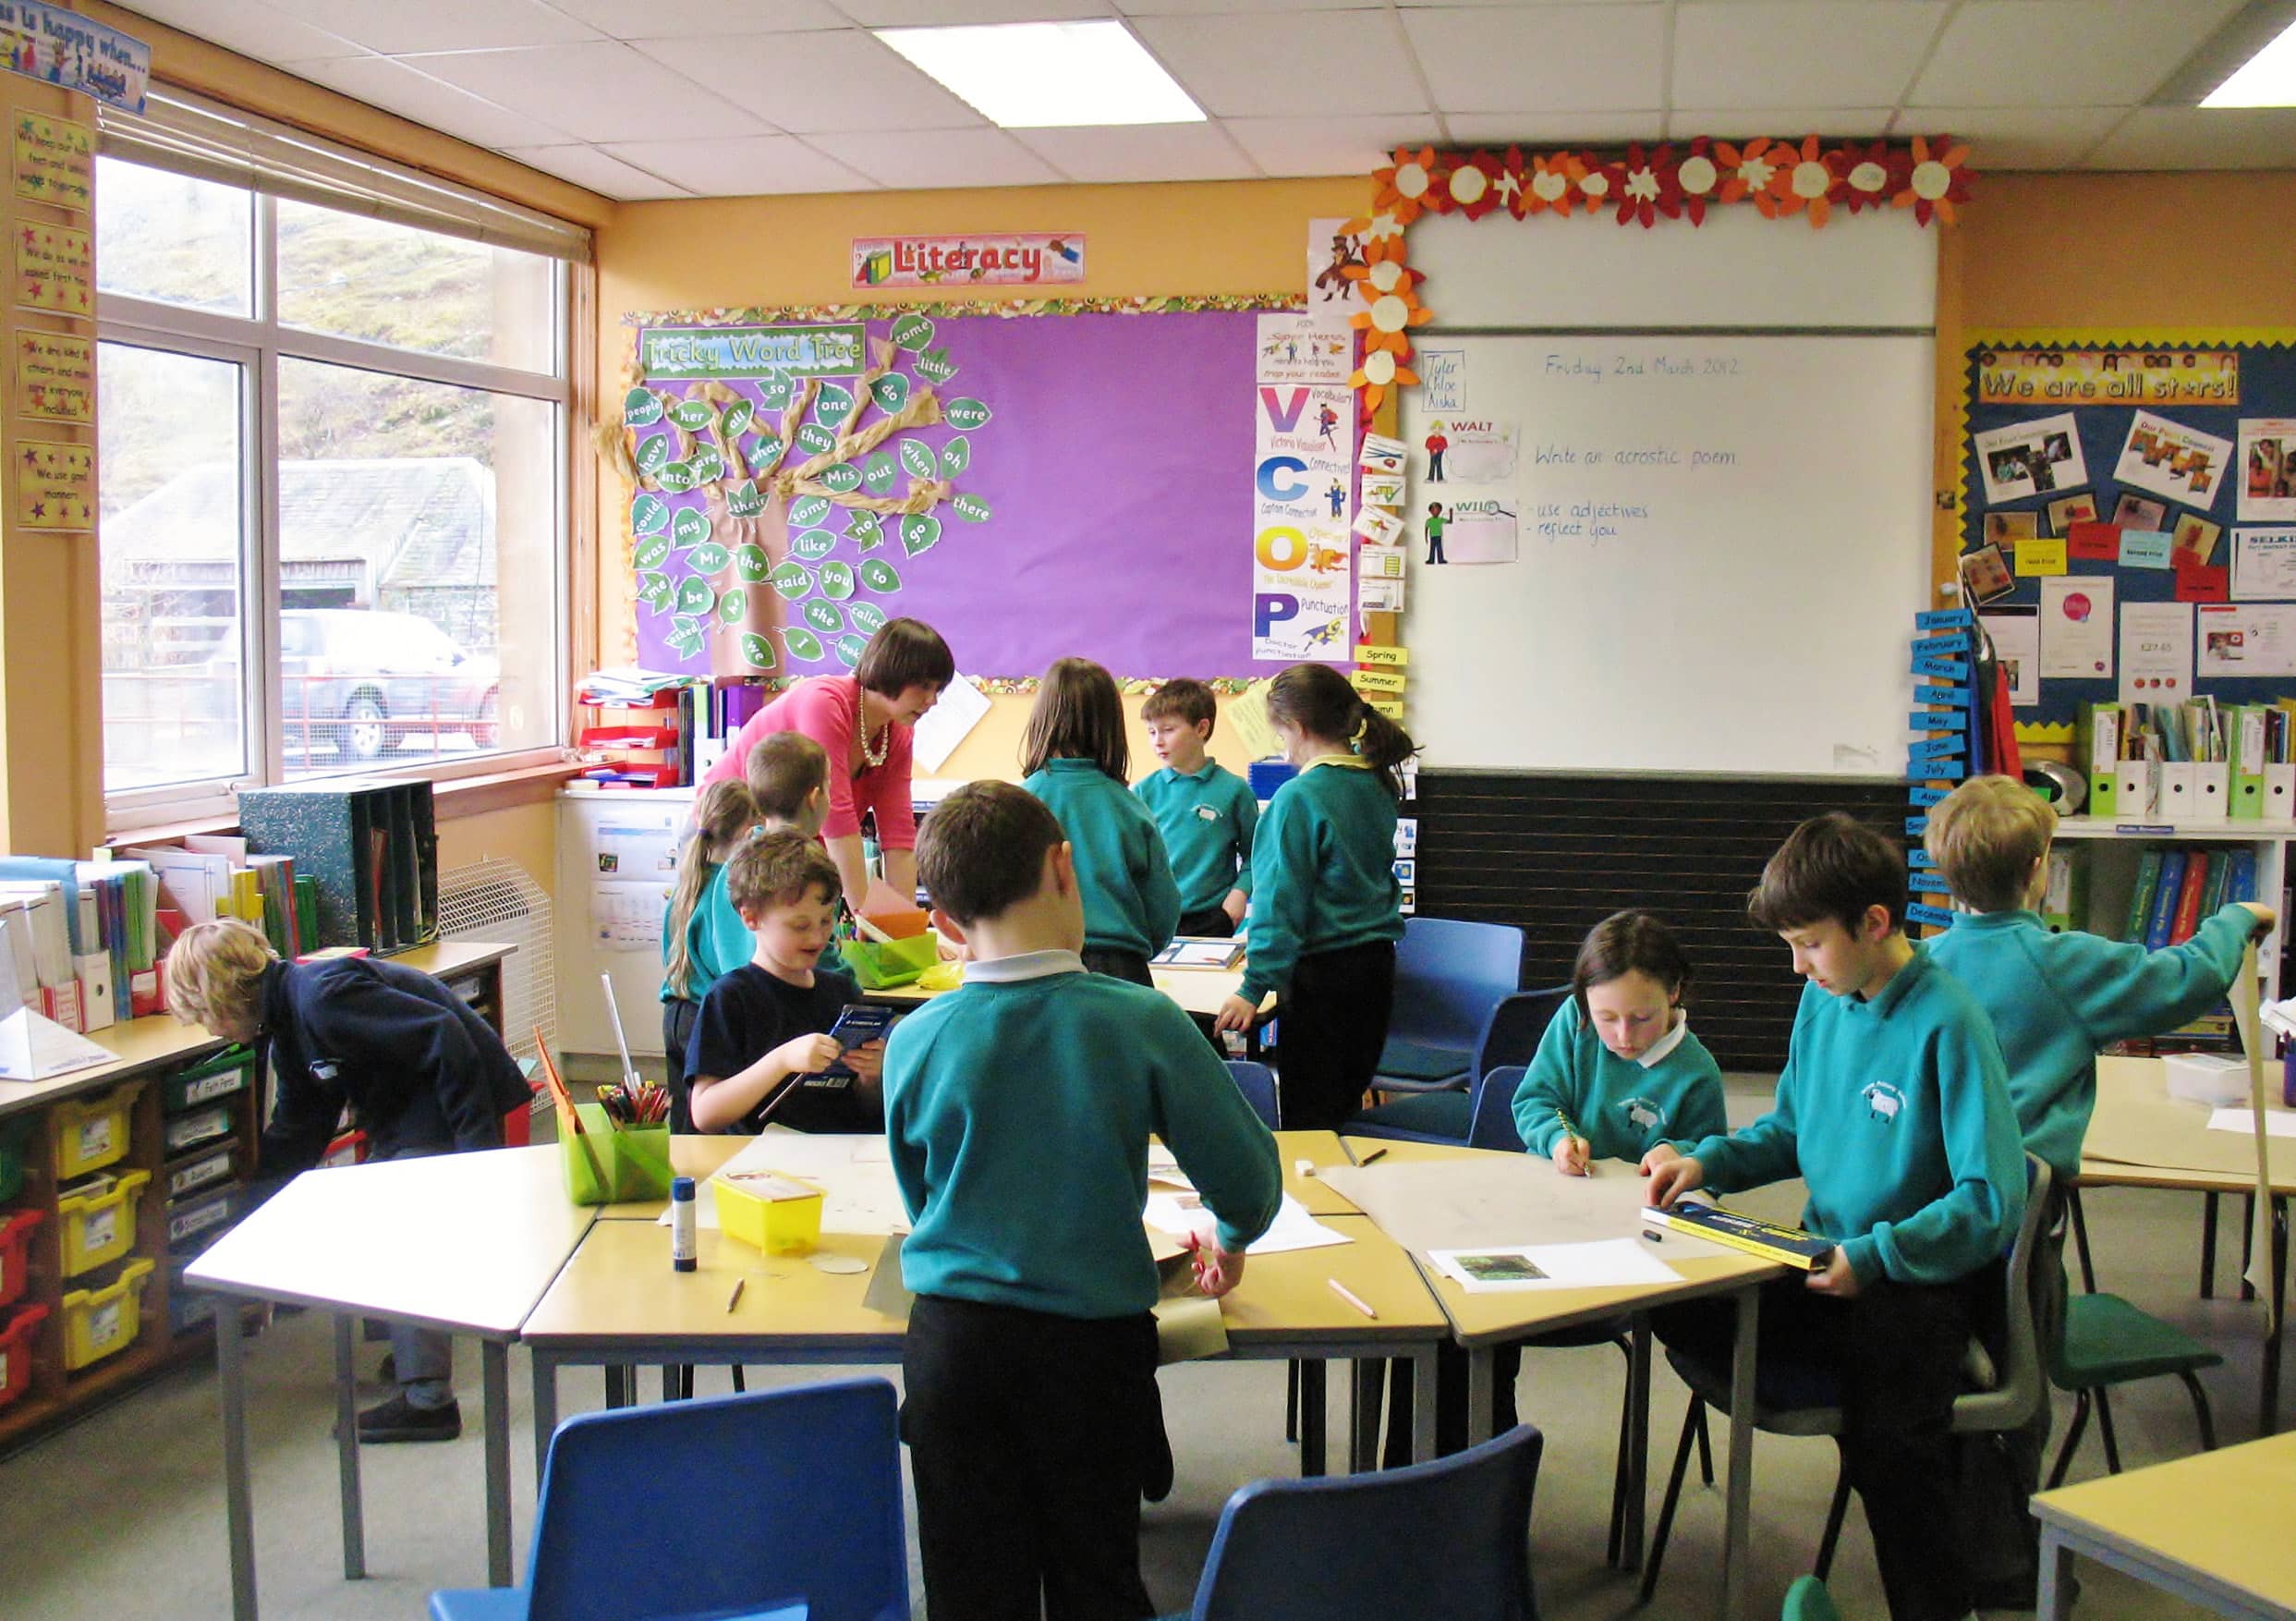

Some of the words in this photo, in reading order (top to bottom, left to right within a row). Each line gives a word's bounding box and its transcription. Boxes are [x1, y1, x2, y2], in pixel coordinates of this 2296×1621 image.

[43, 11, 94, 57] happy
[893, 239, 1042, 282] Literacy
[895, 320, 929, 345] come
[648, 339, 719, 370] Tricky
[729, 338, 801, 362] Word
[810, 335, 862, 360] Tree
[920, 358, 953, 376] little
[1427, 355, 1457, 378] Tyler
[1546, 354, 1602, 383] Friday
[1615, 356, 1644, 375] 2nd
[1653, 356, 1695, 374] March
[769, 384, 786, 396] so
[881, 383, 898, 402] do
[1426, 376, 1456, 394] Chloe
[1984, 372, 2035, 397] We
[2044, 379, 2097, 398] are
[2107, 373, 2144, 399] all
[626, 401, 662, 421] people
[820, 400, 848, 412] one
[950, 407, 986, 420] were
[1259, 387, 1311, 433] V
[679, 409, 705, 423] her
[728, 411, 747, 431] all
[1452, 421, 1493, 432] WALT
[799, 428, 832, 451] they
[2182, 435, 2216, 452] Council
[638, 438, 666, 471] have
[696, 452, 719, 469] are
[747, 440, 782, 466] what
[902, 442, 931, 478] when
[943, 452, 962, 469] oh
[1536, 446, 1576, 464] Write
[1584, 451, 1601, 464] an
[1614, 446, 1680, 464] acrostic
[1692, 449, 1736, 472] poem
[37, 469, 52, 480] We
[661, 469, 691, 485] into
[827, 470, 856, 484] Mrs
[867, 465, 893, 482] out
[1257, 456, 1309, 502] C
[732, 496, 767, 513] their
[791, 498, 830, 524] some
[953, 496, 990, 520] there
[1456, 502, 1496, 512] WILF
[635, 503, 663, 533] could
[1537, 505, 1561, 518] use
[1570, 501, 1649, 530] adjectives
[678, 518, 702, 537] my
[855, 520, 874, 537] no
[909, 523, 927, 543] go
[1537, 520, 1583, 538] reflect
[1589, 522, 1618, 547] you
[639, 542, 667, 564] was
[800, 540, 828, 553] like
[1256, 526, 1308, 571] O
[699, 552, 723, 566] Mr
[739, 555, 762, 572] the
[775, 574, 808, 590] said
[823, 570, 851, 589] you
[871, 568, 888, 585] to
[648, 579, 668, 600] me
[686, 590, 704, 603] be
[1255, 593, 1299, 637] P
[1301, 598, 1348, 615] Punctuation
[810, 606, 836, 627] she
[851, 605, 888, 630] called
[1924, 613, 1965, 625] January
[668, 625, 699, 645] asked
[747, 640, 765, 663] we
[1916, 639, 1962, 652] February
[1366, 649, 1397, 662] Spring
[1923, 661, 1955, 673] March
[1359, 674, 1398, 686] Summer
[1931, 689, 1955, 700] April
[1927, 716, 1949, 726] May
[1925, 741, 1948, 753] June
[1924, 764, 1946, 775] July
